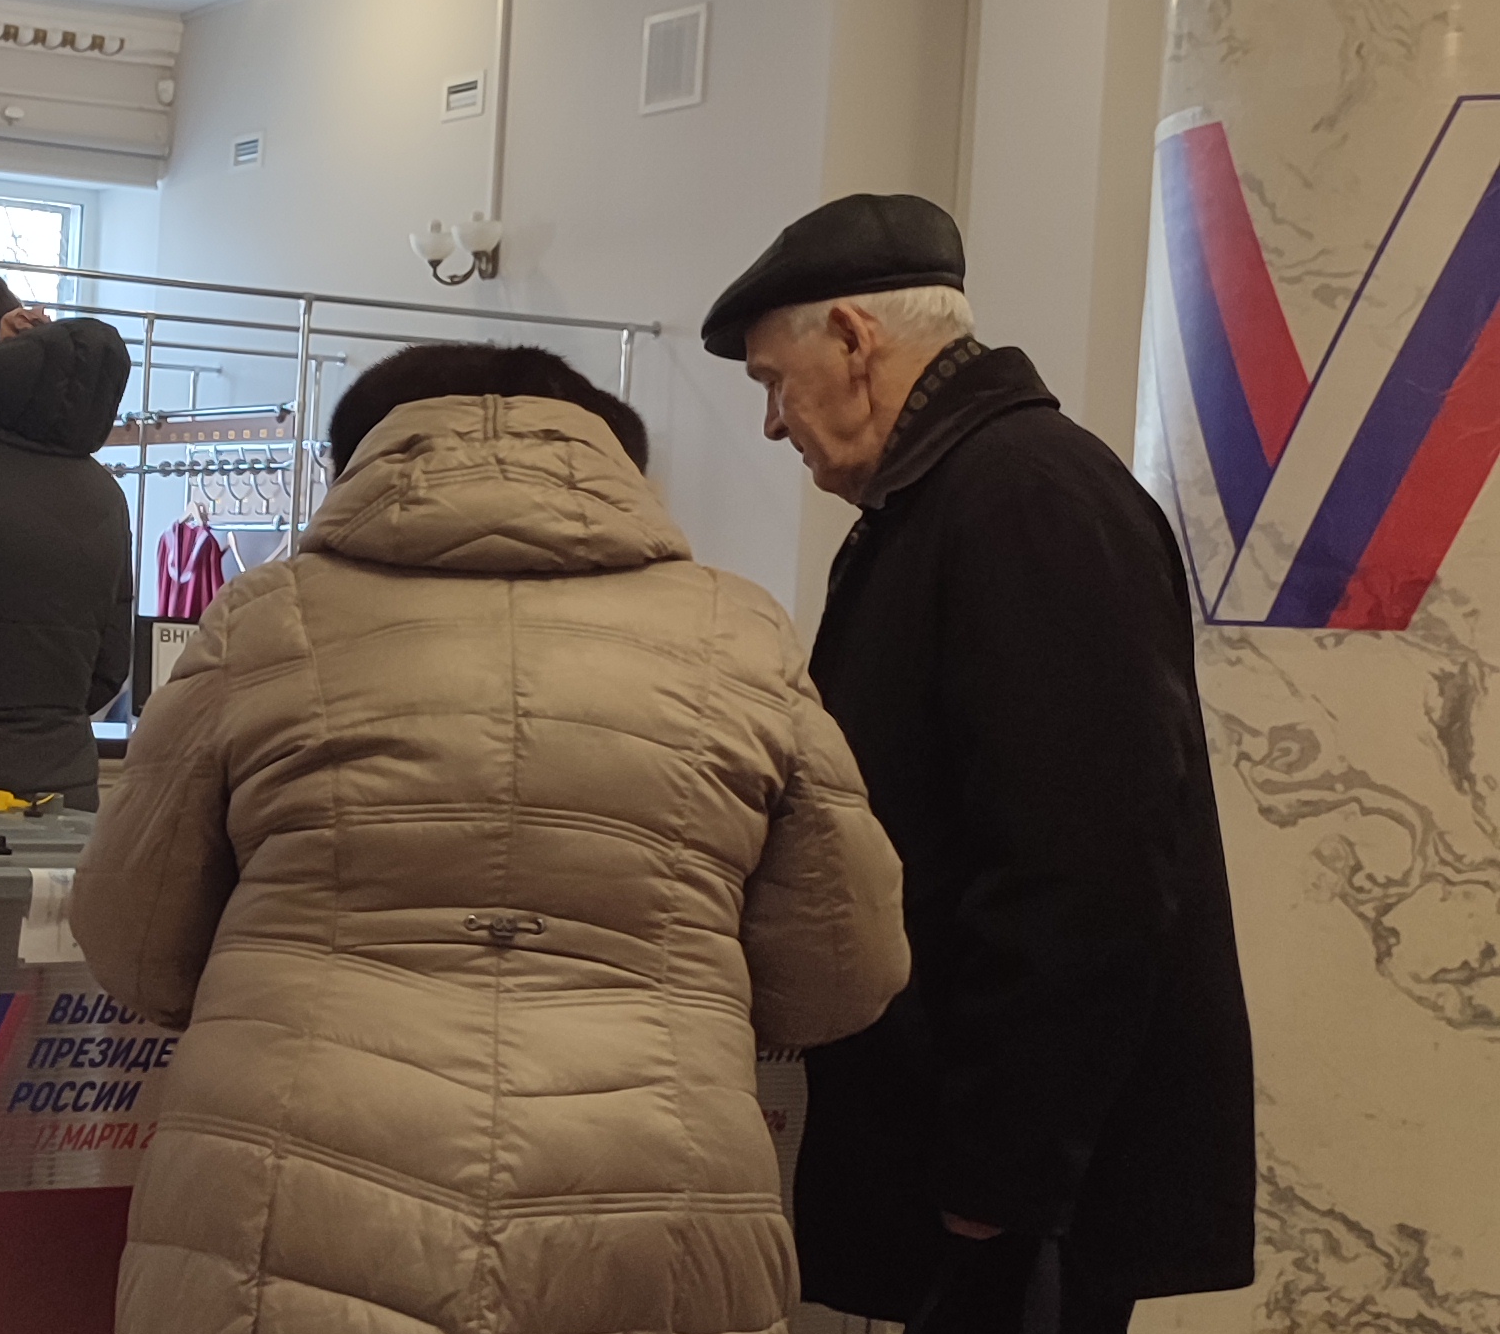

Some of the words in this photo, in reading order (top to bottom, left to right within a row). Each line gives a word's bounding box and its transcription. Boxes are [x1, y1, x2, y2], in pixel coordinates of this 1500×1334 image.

[27, 1036, 180, 1073] ПРЕЗИДЕ
[6, 1079, 144, 1114] РОССИИ
[57, 1121, 139, 1152] МАРТА
